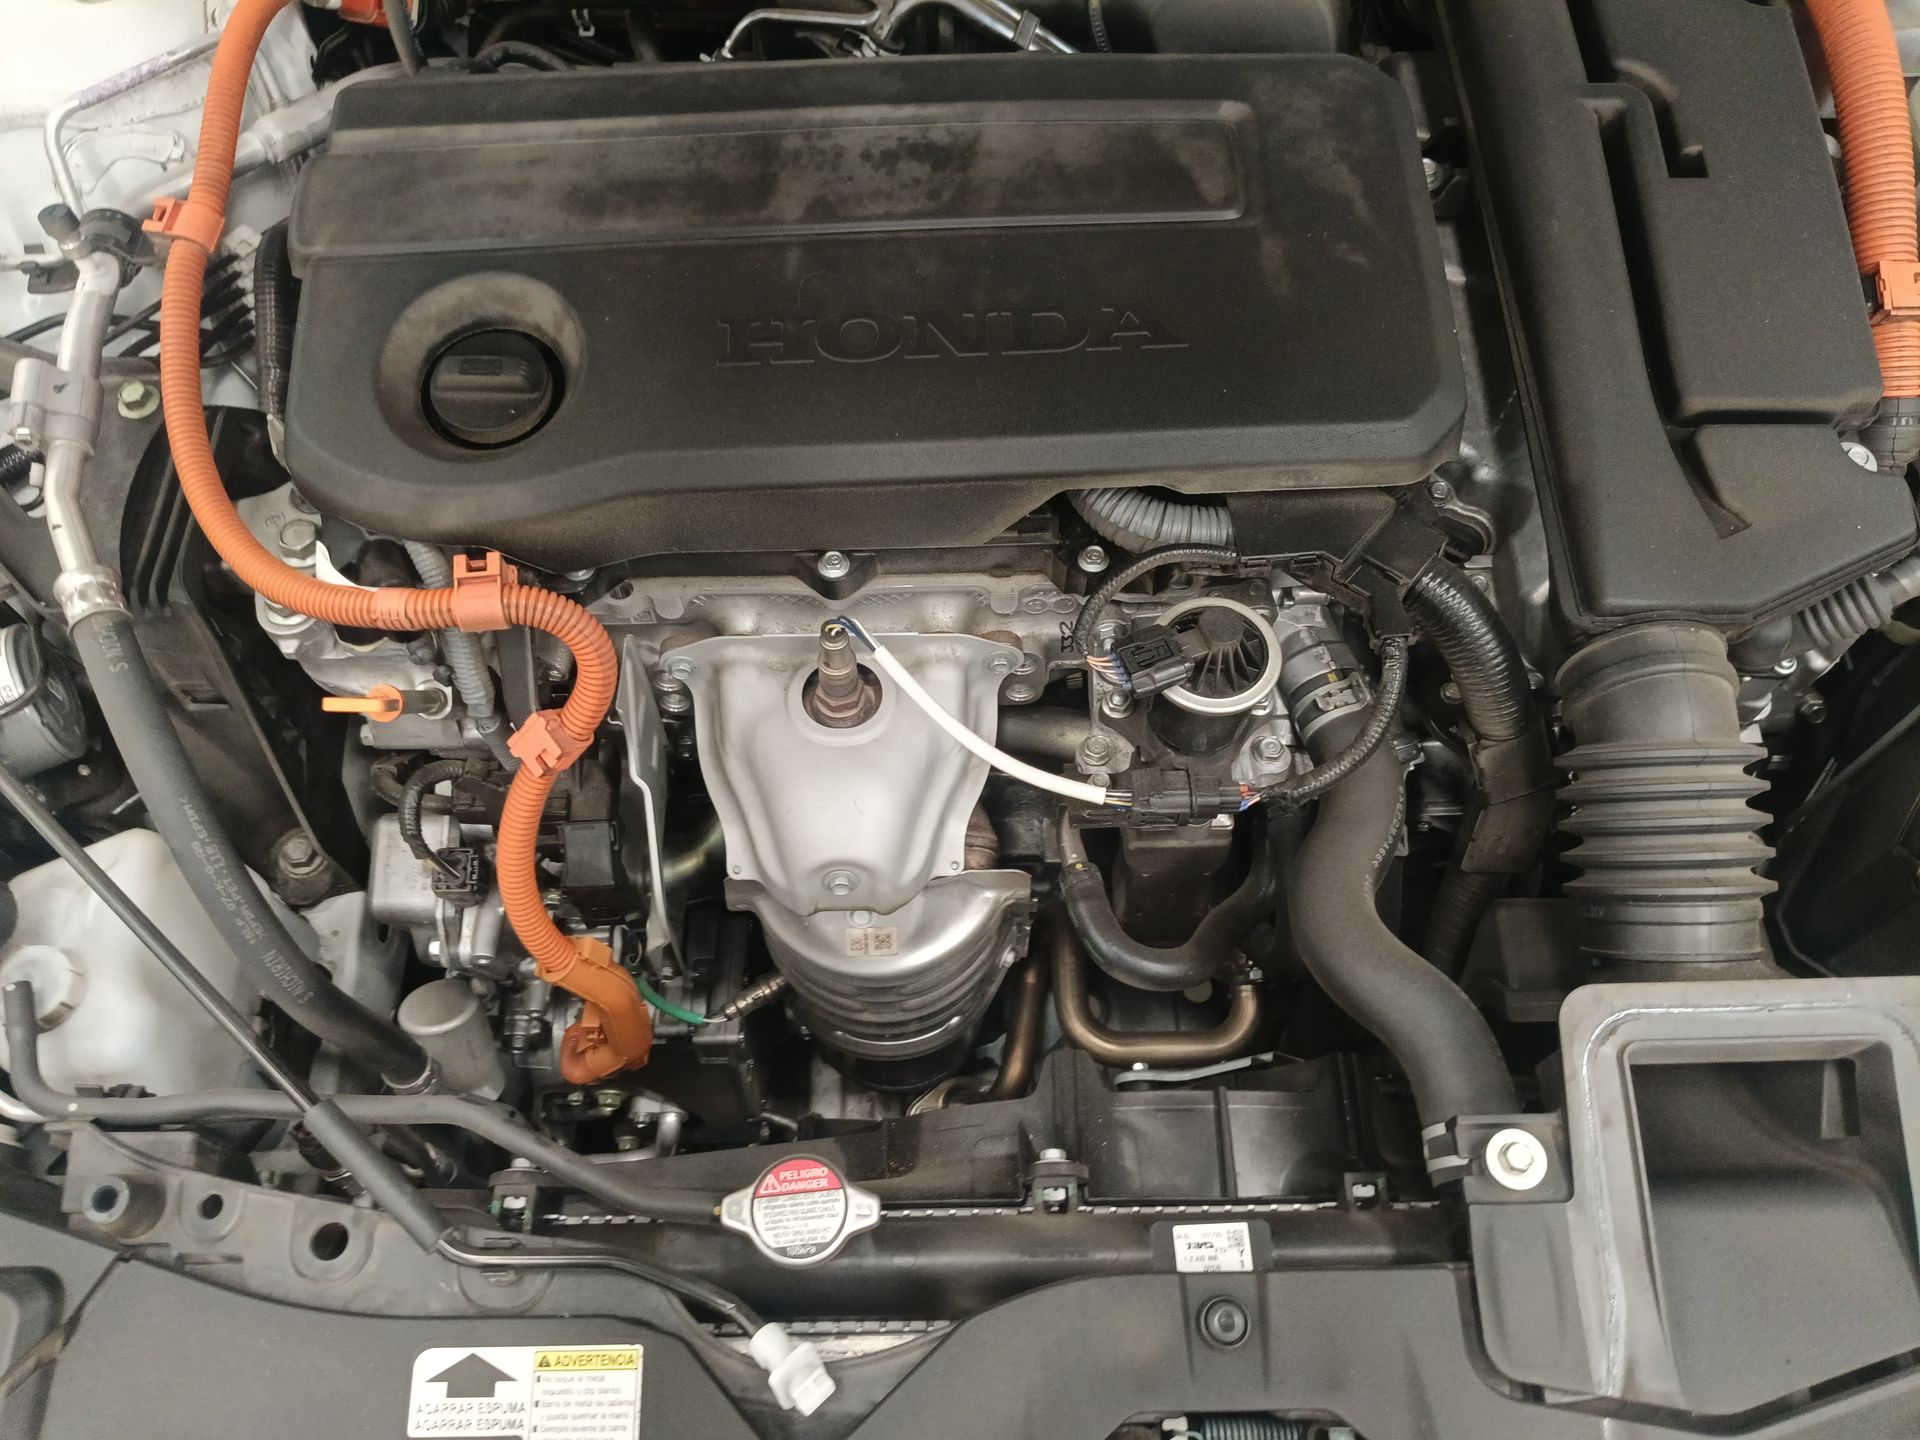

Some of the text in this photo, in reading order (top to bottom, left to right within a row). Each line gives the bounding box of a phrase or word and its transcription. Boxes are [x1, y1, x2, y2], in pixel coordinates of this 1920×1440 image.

[716, 308, 1190, 366] HONDA
[779, 1166, 829, 1181] PELIGRO
[780, 1177, 829, 1192] DANGER
[554, 1354, 634, 1367] ADVERTENCIA
[478, 1402, 526, 1414] ESPUMA
[476, 1418, 524, 1431] ESPUMA
